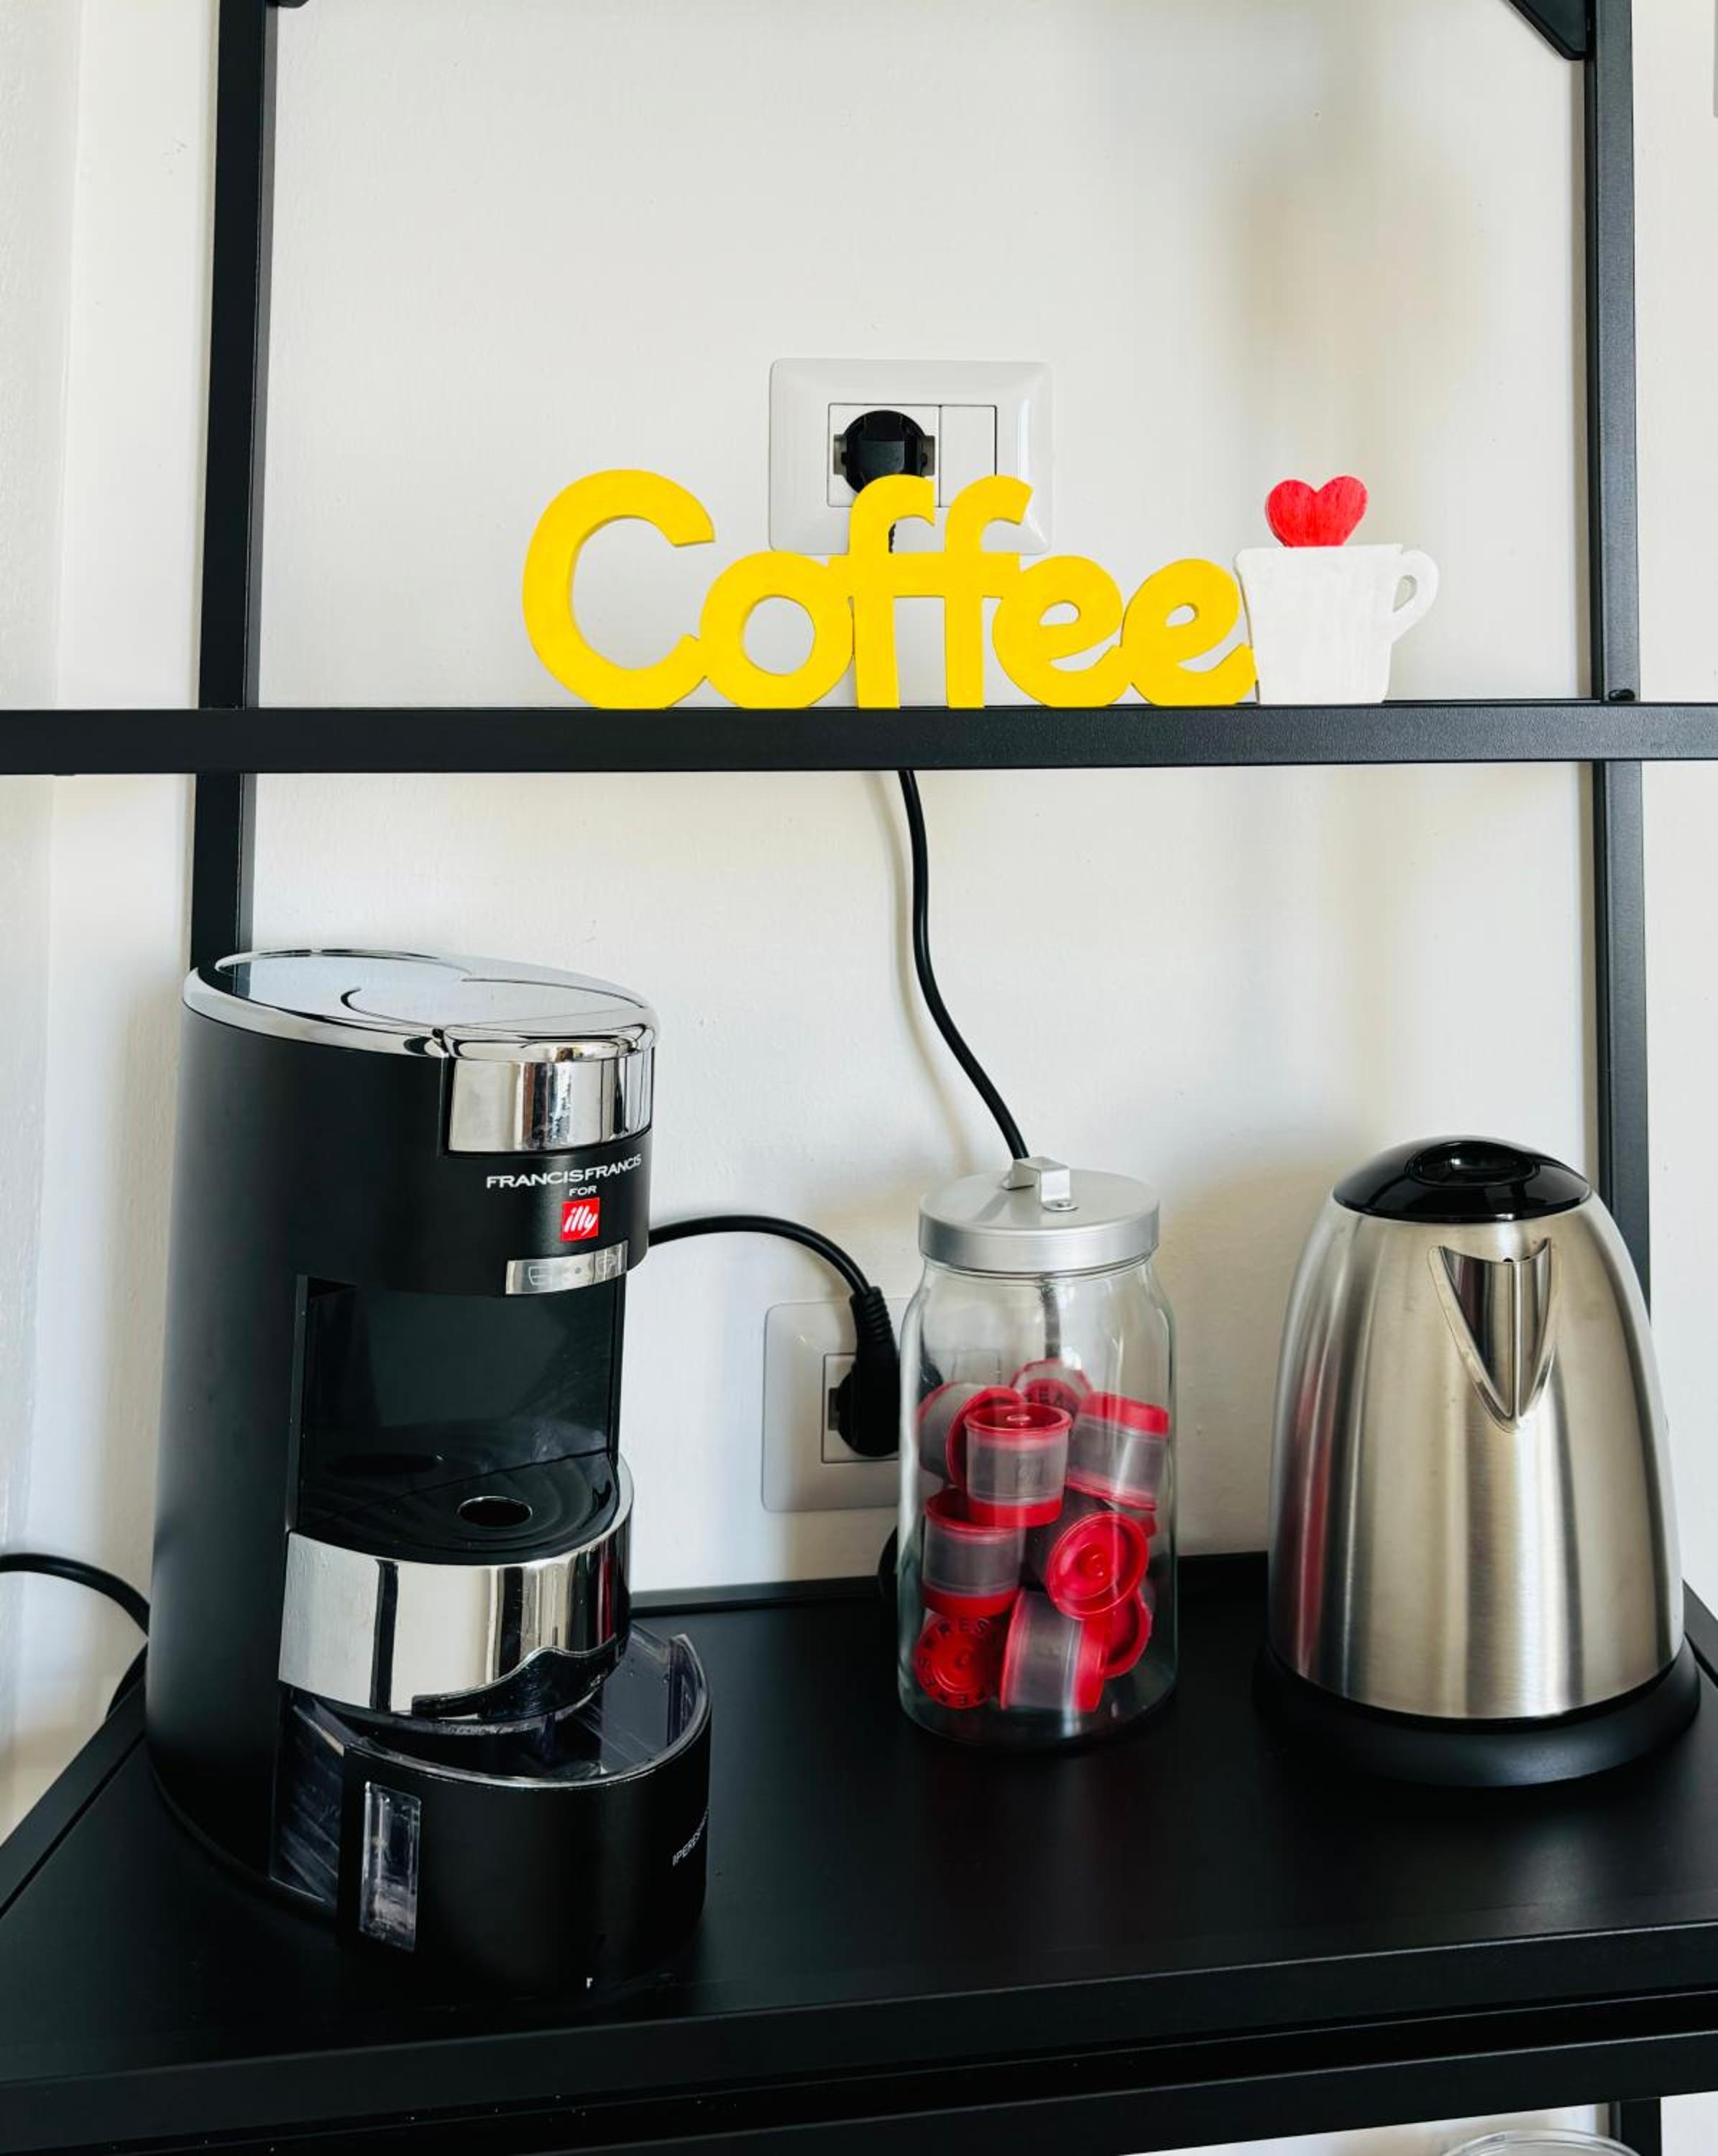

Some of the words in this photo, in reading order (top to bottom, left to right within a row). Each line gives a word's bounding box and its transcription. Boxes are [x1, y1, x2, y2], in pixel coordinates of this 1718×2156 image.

[523, 469, 1259, 709] Coffee
[486, 1153, 642, 1189] FRANCISFRANCIS
[569, 1185, 597, 1197] FOR
[564, 1204, 598, 1236] illy
